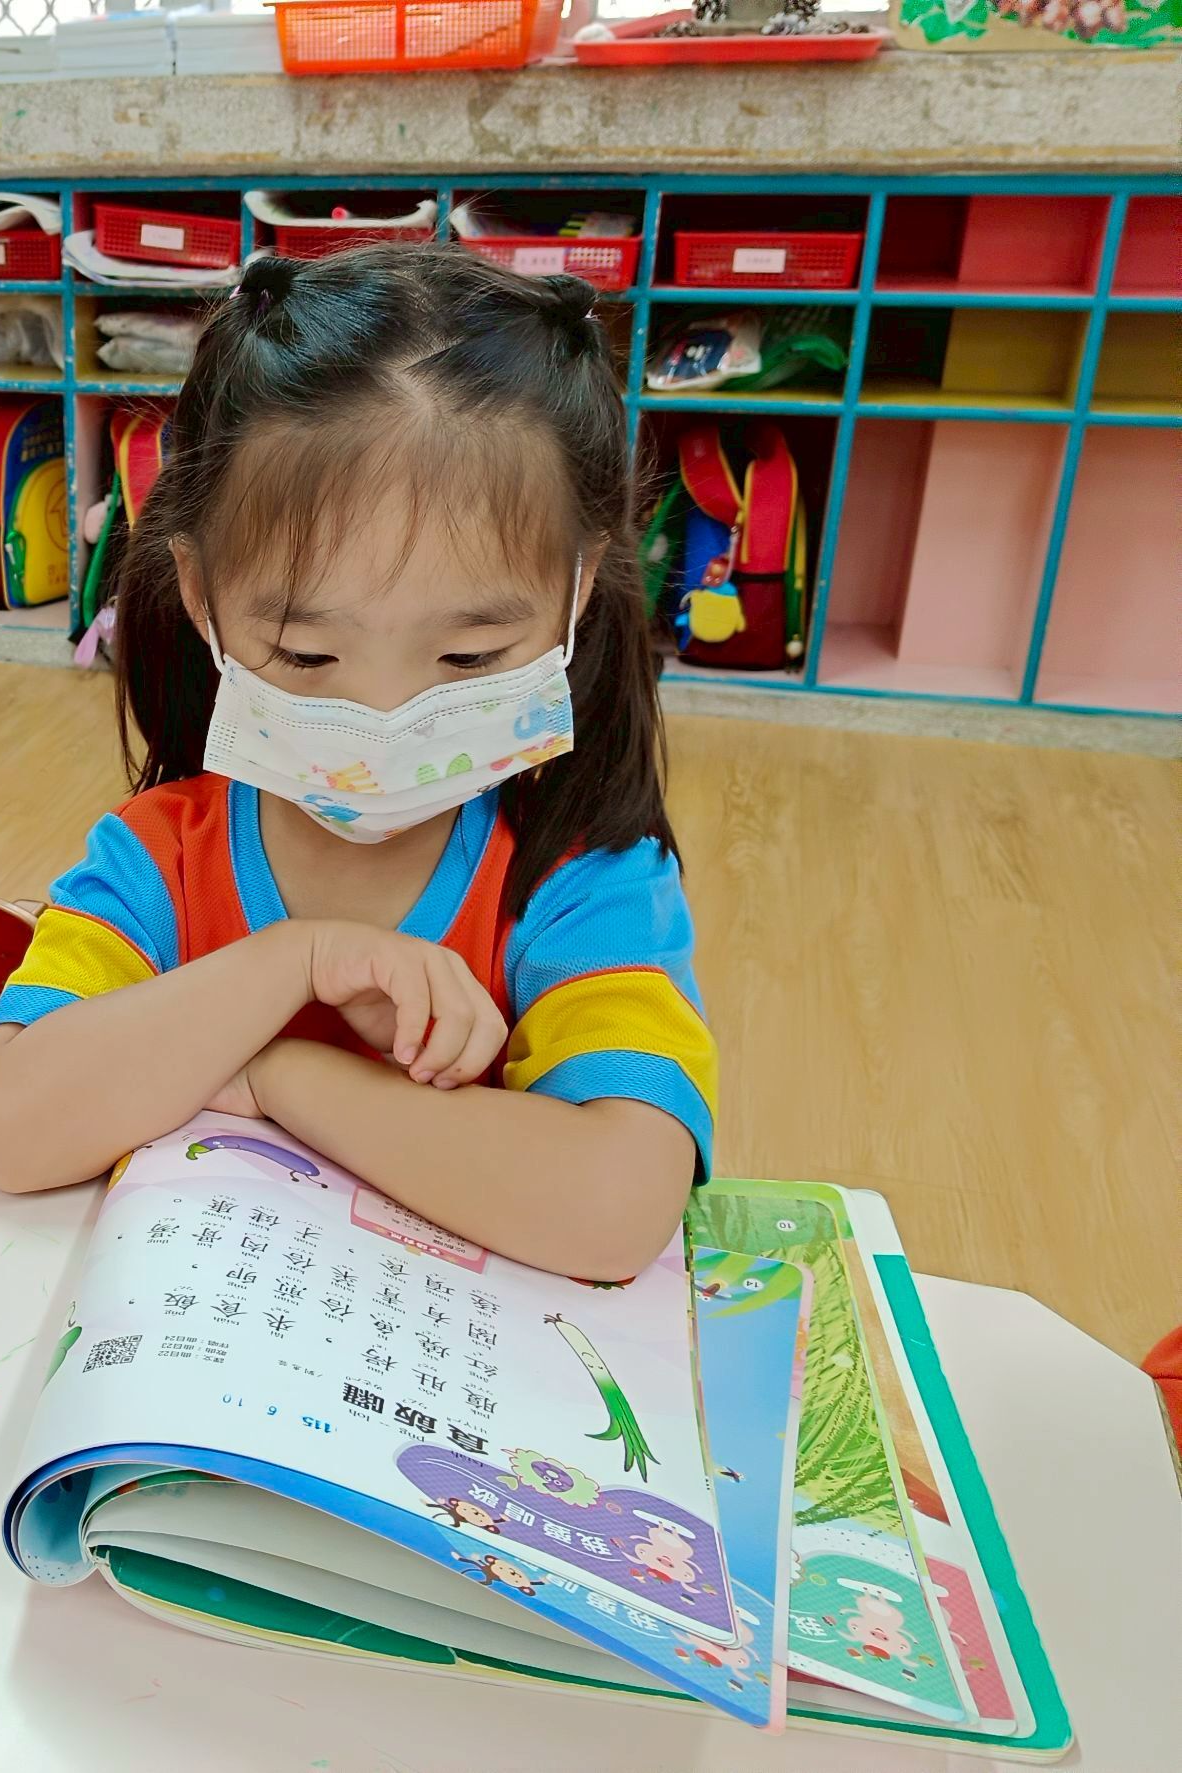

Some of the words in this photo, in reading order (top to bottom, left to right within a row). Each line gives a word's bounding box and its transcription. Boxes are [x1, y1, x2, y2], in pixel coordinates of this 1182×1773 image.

[746, 1280, 759, 1288] 14
[222, 1394, 243, 1407] 10
[267, 1405, 278, 1416] 6
[342, 1382, 489, 1456] 食飯囉
[467, 1483, 613, 1556] 我愛唱歌
[515, 1557, 660, 1632] 我愛唱
